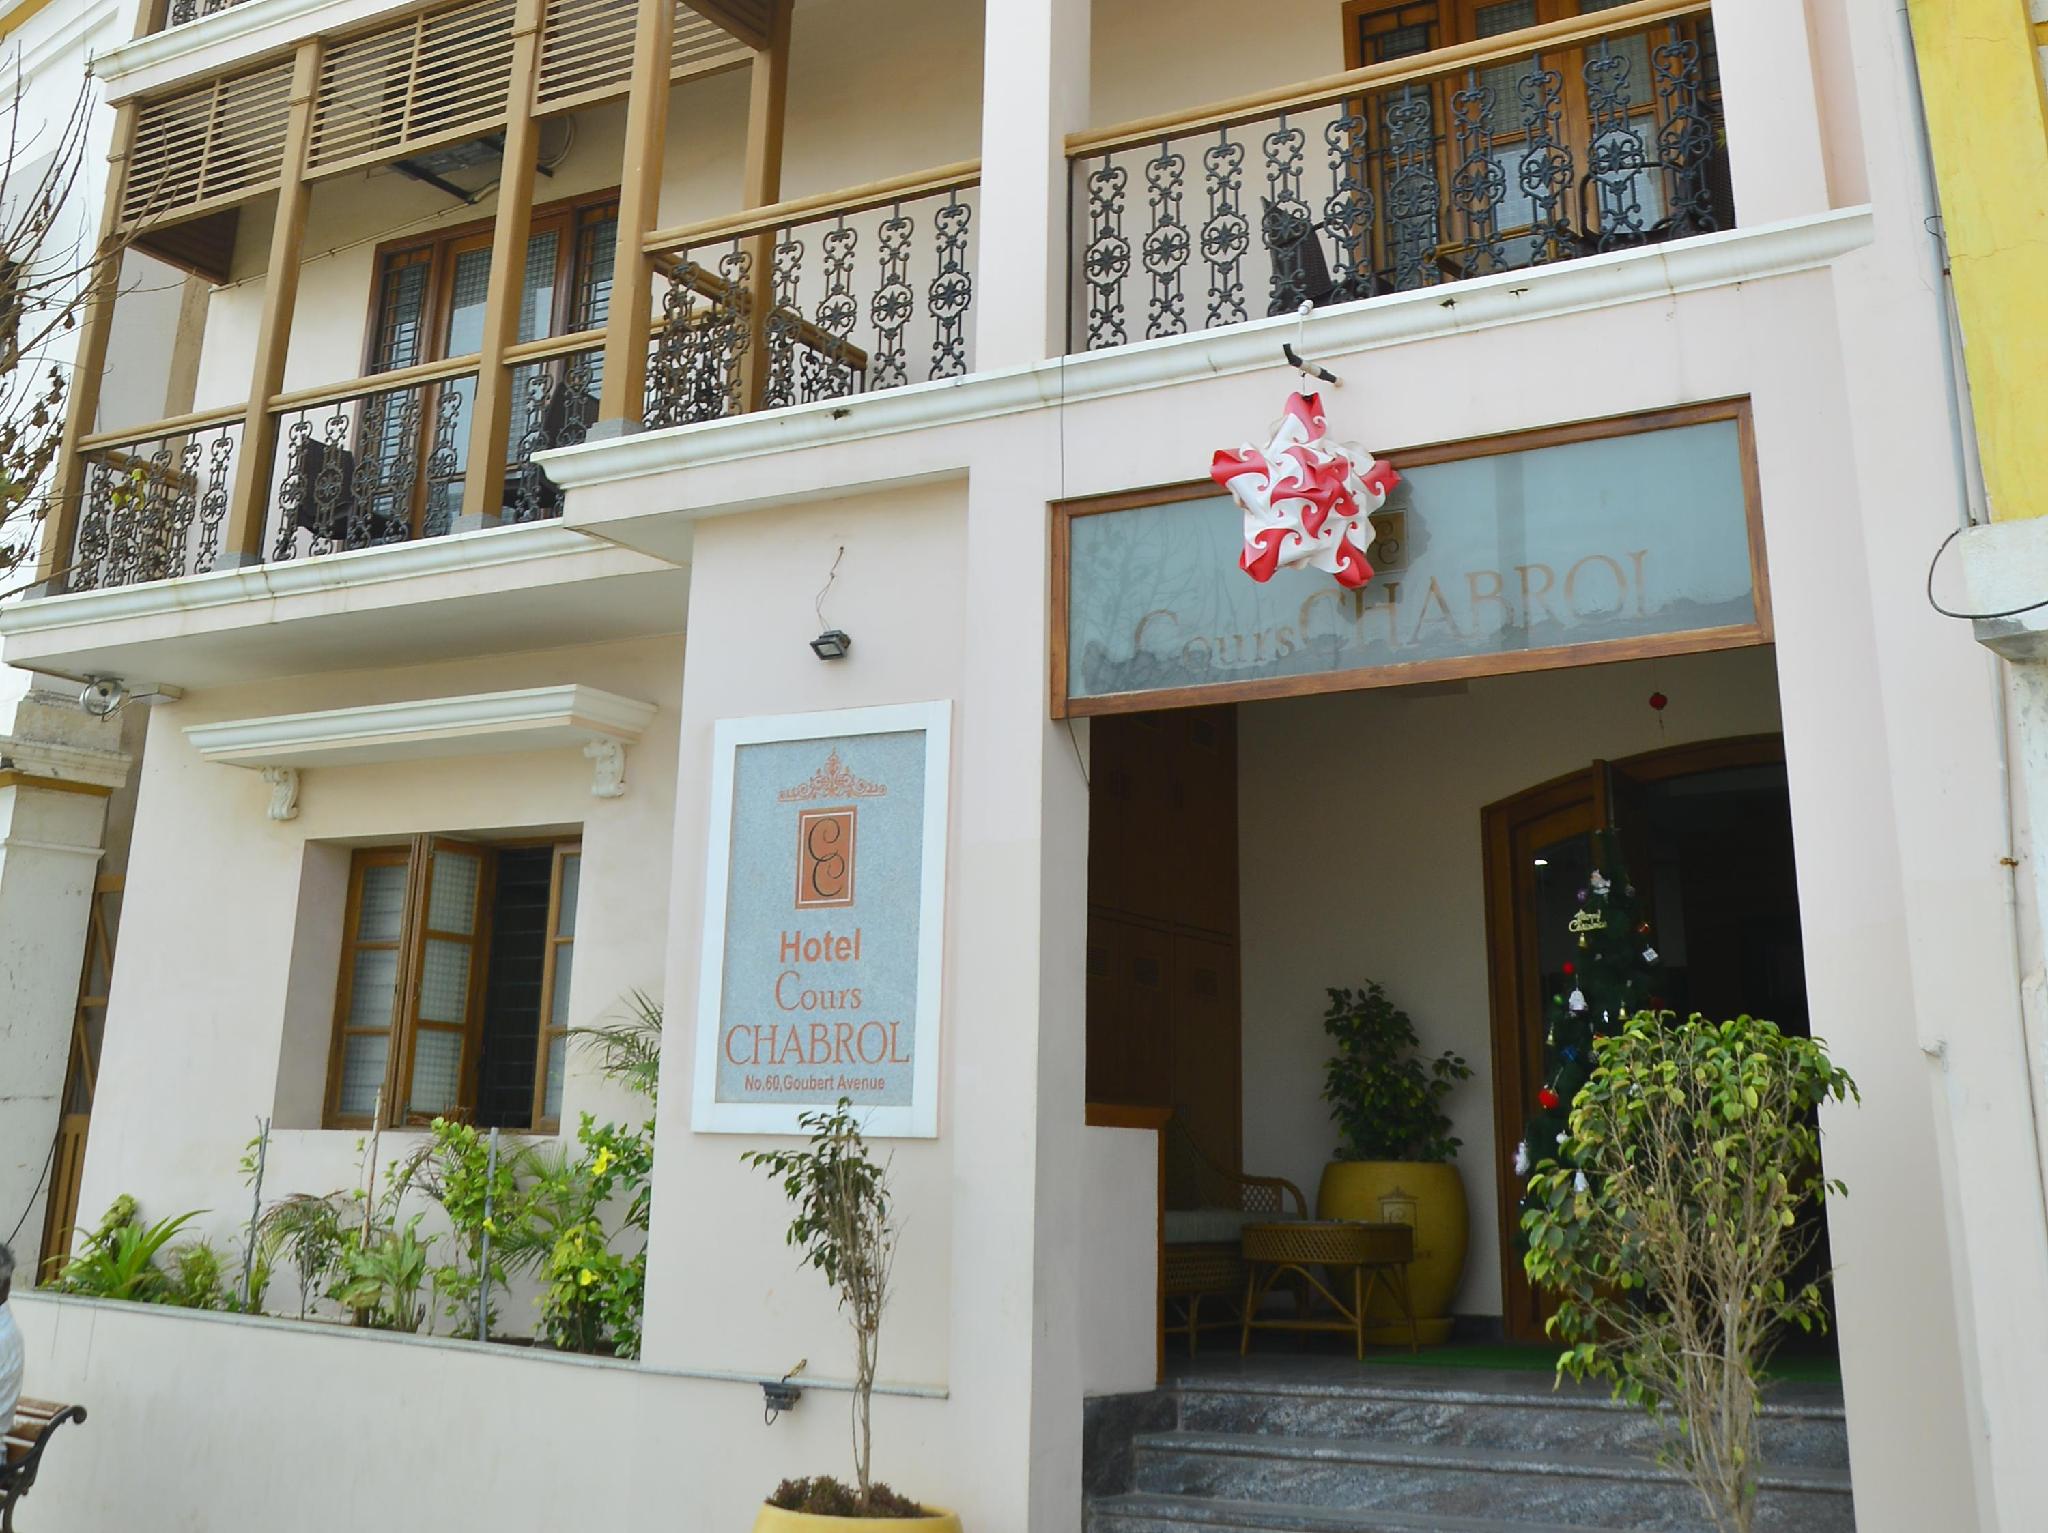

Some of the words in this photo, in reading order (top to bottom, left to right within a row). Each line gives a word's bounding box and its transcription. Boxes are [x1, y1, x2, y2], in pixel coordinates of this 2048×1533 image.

[1133, 608, 1296, 680] Cours
[780, 927, 862, 964] Hotel
[775, 970, 863, 1011] Cours
[725, 1020, 910, 1065] CHABROL
[837, 1074, 885, 1091] Avenue
